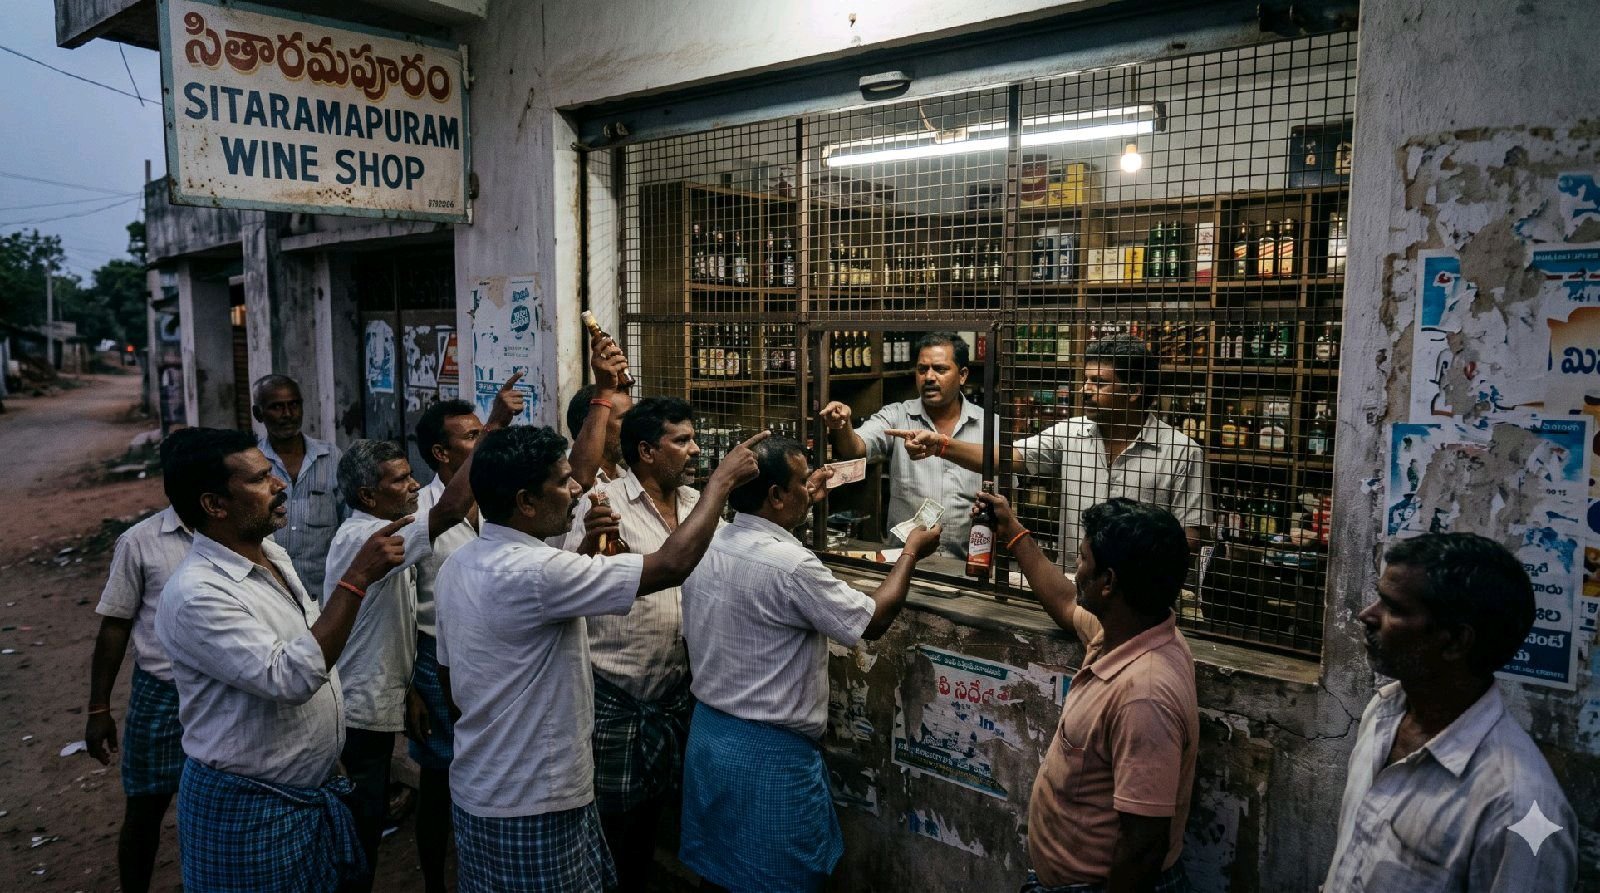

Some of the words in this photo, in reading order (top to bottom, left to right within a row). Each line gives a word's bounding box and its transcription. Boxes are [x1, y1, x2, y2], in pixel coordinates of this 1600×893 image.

[184, 81, 460, 150] SITARAMAPURAM
[220, 136, 319, 183] WINE
[335, 149, 425, 190] SHOP
